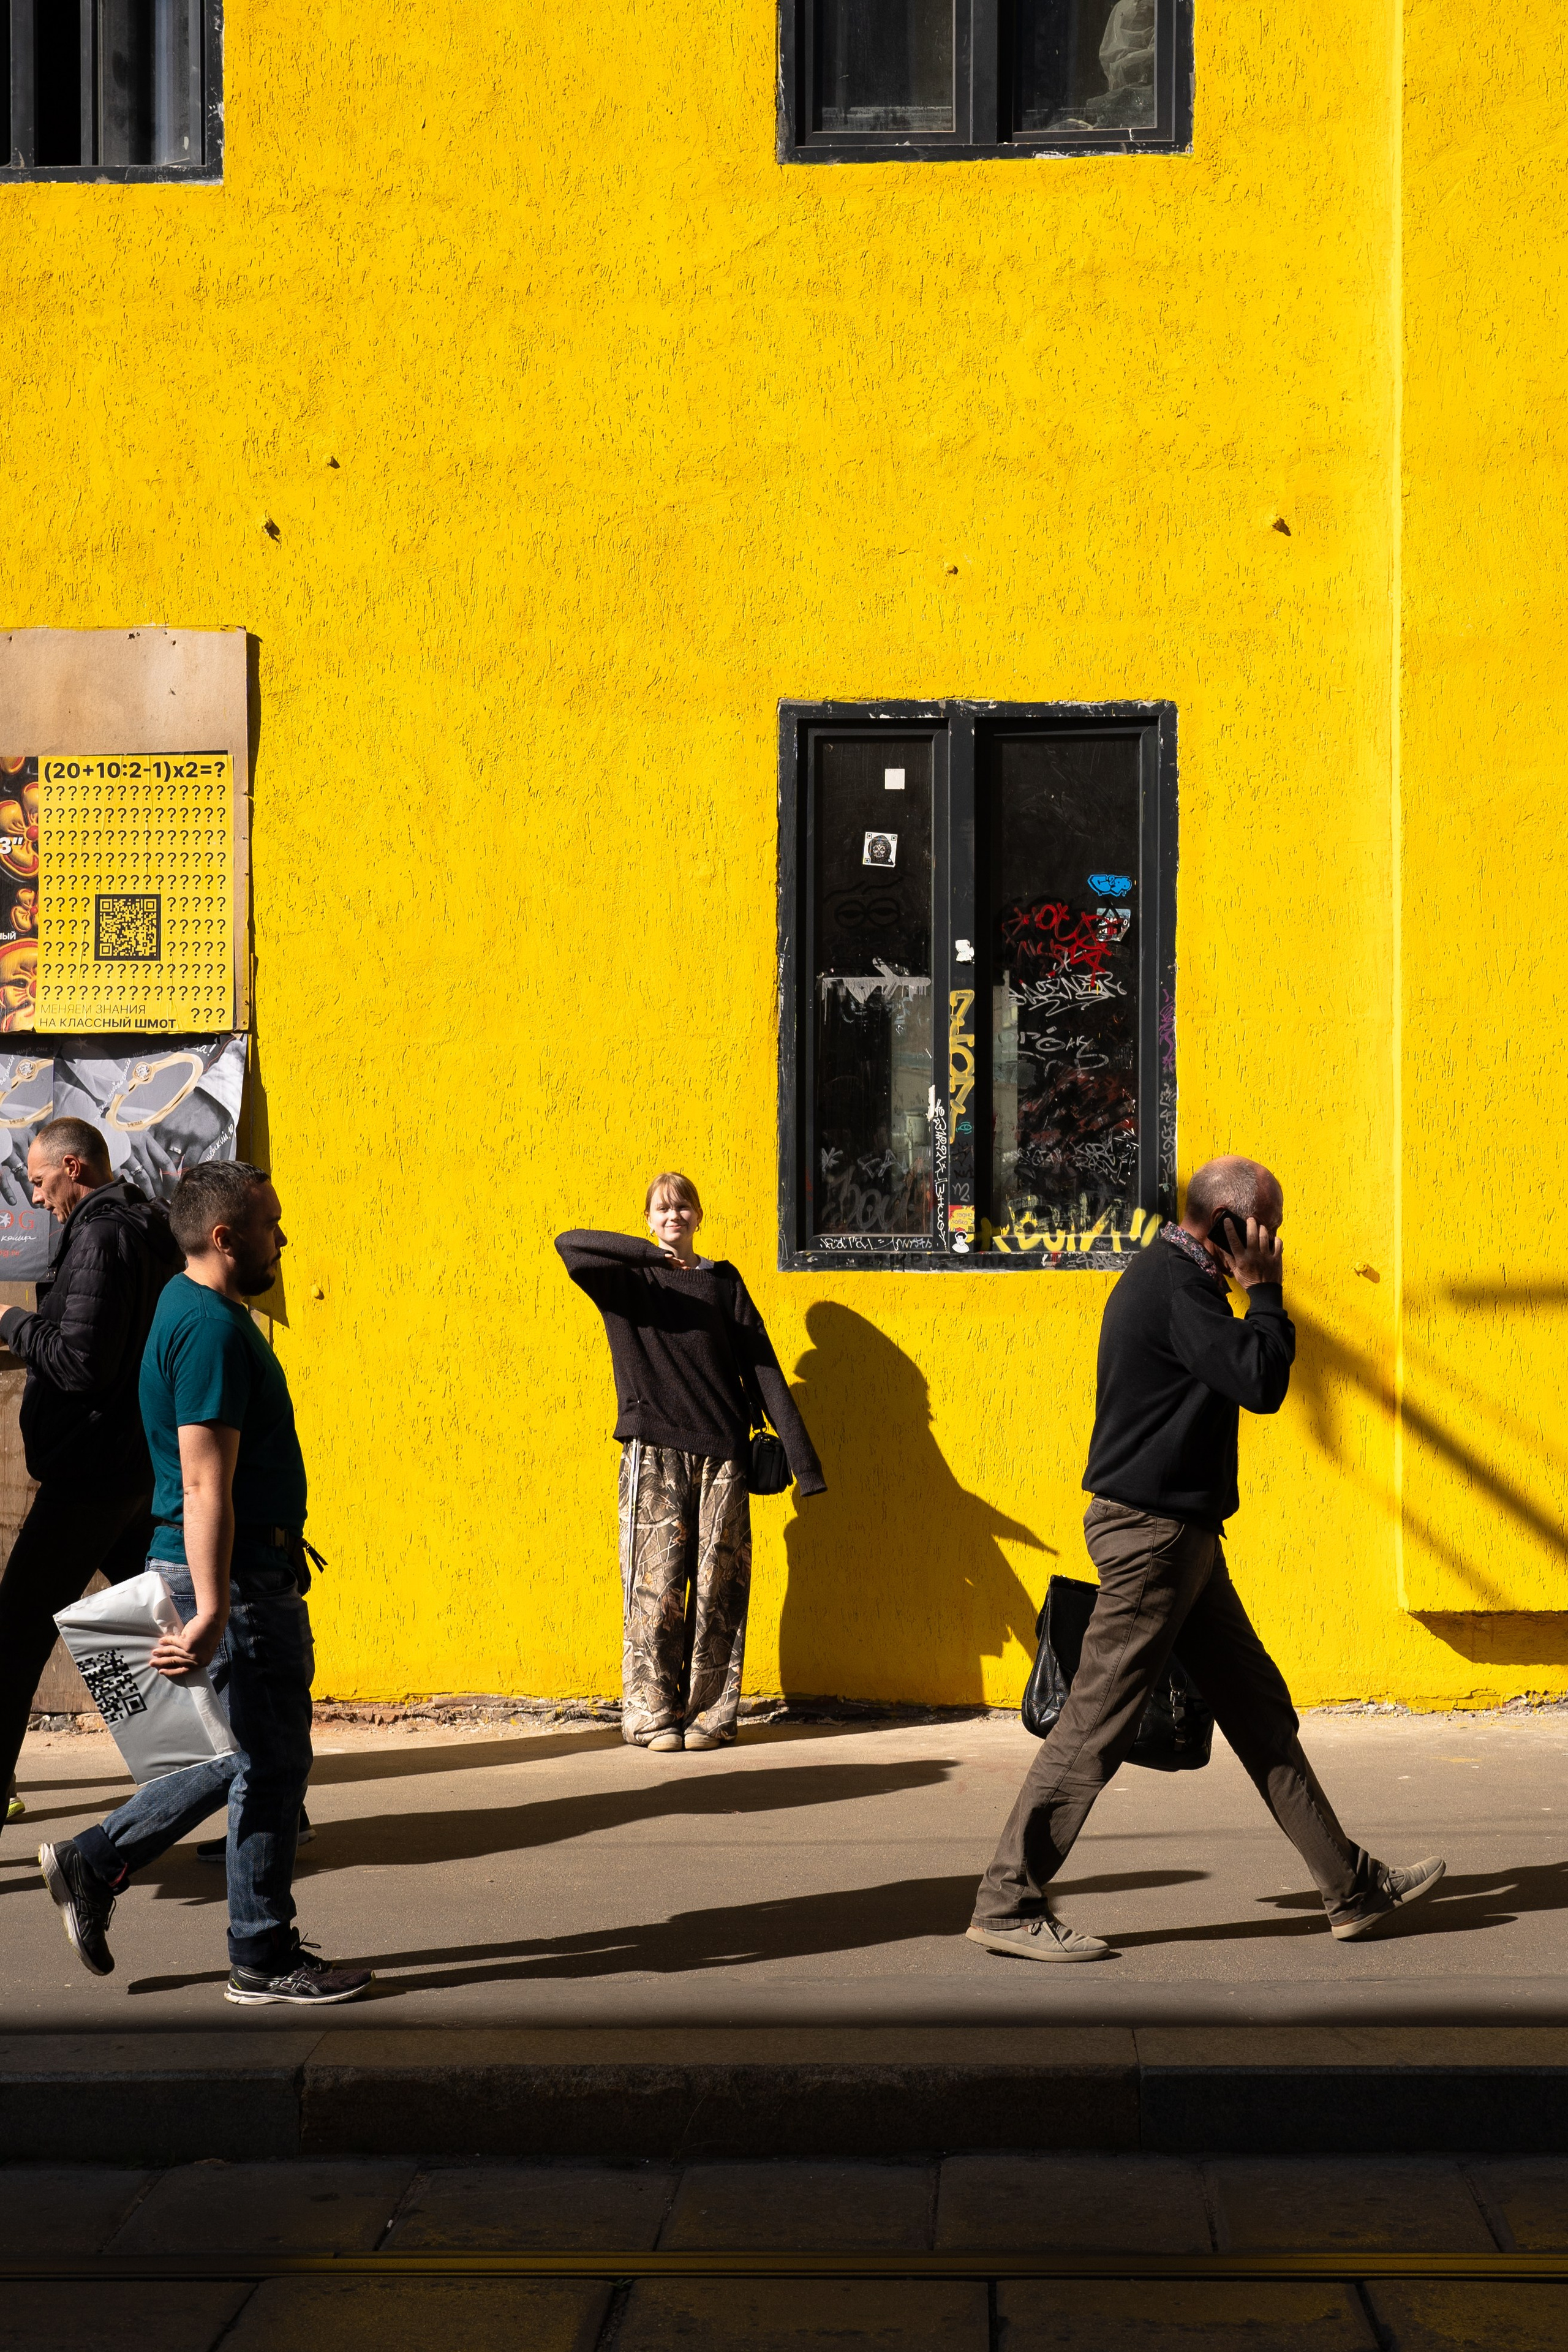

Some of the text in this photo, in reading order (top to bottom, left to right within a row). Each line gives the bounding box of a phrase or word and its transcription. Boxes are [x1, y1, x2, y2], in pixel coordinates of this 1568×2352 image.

[40, 1005, 146, 1014] МЕНЯЕМ ЗНАНИЯ
[40, 1017, 176, 1028] НА КЛАССНЫЙ ШМОТ
